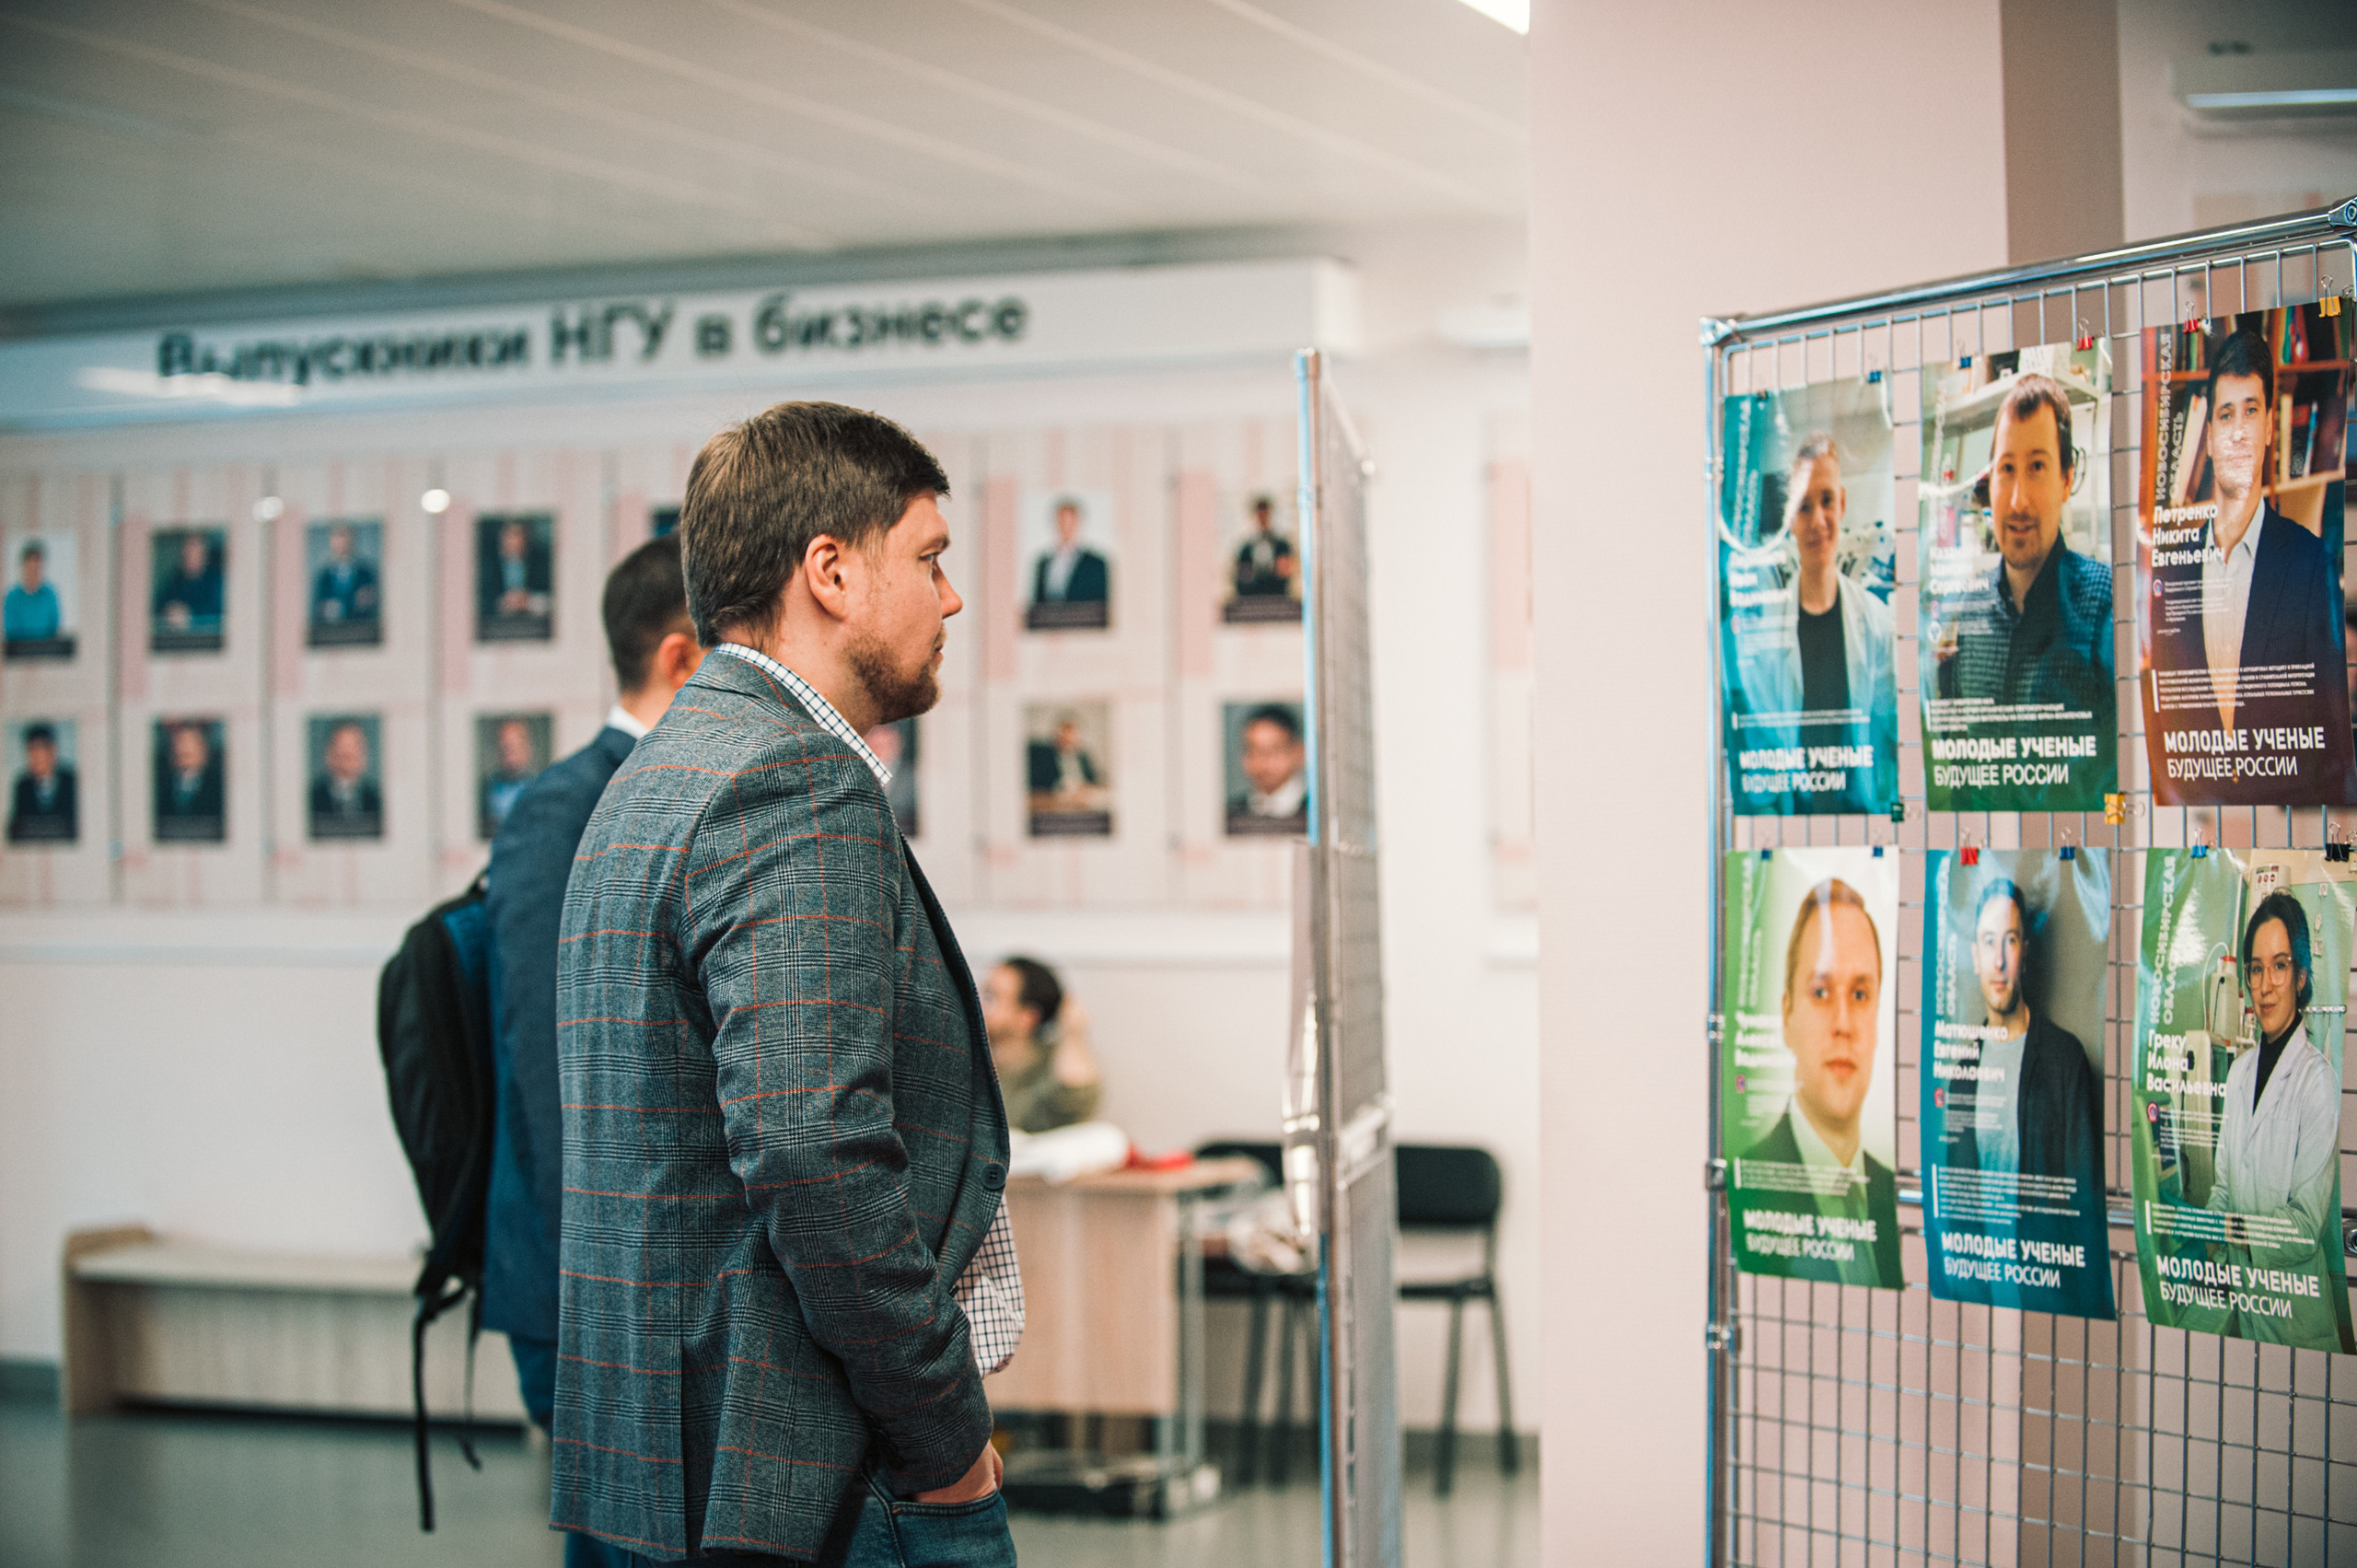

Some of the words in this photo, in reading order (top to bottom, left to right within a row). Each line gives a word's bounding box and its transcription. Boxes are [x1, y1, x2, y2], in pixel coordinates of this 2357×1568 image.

[552, 297, 674, 363] НГУ
[695, 314, 733, 359] в
[753, 291, 1028, 354] бизнесе
[2155, 333, 2172, 500] НОВОСИБИРСКАЯ
[2154, 504, 2218, 526] Петренко
[2153, 528, 2200, 546] Никита
[2152, 548, 2225, 567] Евгеньевич
[1932, 738, 2016, 762] МОЛОДЫЕ
[2021, 736, 2096, 758] УЧЕНЫЕ
[2164, 729, 2248, 755] МОЛОДЫЕ
[2252, 726, 2325, 750] УЧЕНЫЕ
[1739, 747, 1805, 771] МОЛОДЫЕ
[1807, 745, 1874, 769] УЧЕНЫЕ
[2166, 758, 2233, 781] БУДУЩЕЕ
[2235, 756, 2298, 777] РОССИИ
[1792, 771, 1846, 792] РОССИИ
[1934, 765, 1999, 789] БУДУЩЕЕ
[2003, 763, 2069, 785] РОССИИ
[2150, 856, 2176, 1024] НОВОСИБИРСКАЯ
[1933, 1040, 1980, 1060] Евгений
[2148, 1029, 2187, 1054] Греку
[1933, 1060, 2005, 1082] Николаевич
[2147, 1051, 2189, 1072] Илона
[2146, 1073, 2227, 1098] Васильевна
[1941, 1232, 2016, 1260] МОЛОДЫЕ
[2020, 1240, 2085, 1267] УЧЕНЫЕ
[1944, 1256, 2002, 1282] БУДУЩЕЕ
[2004, 1264, 2061, 1288] РОССИИ
[2156, 1255, 2242, 1286] МОЛОДЫЕ
[2246, 1267, 2320, 1297] УЧЕНЫЕ
[2160, 1281, 2226, 1310] БУДУЩЕЕ
[2229, 1292, 2293, 1318] РОССИИ
